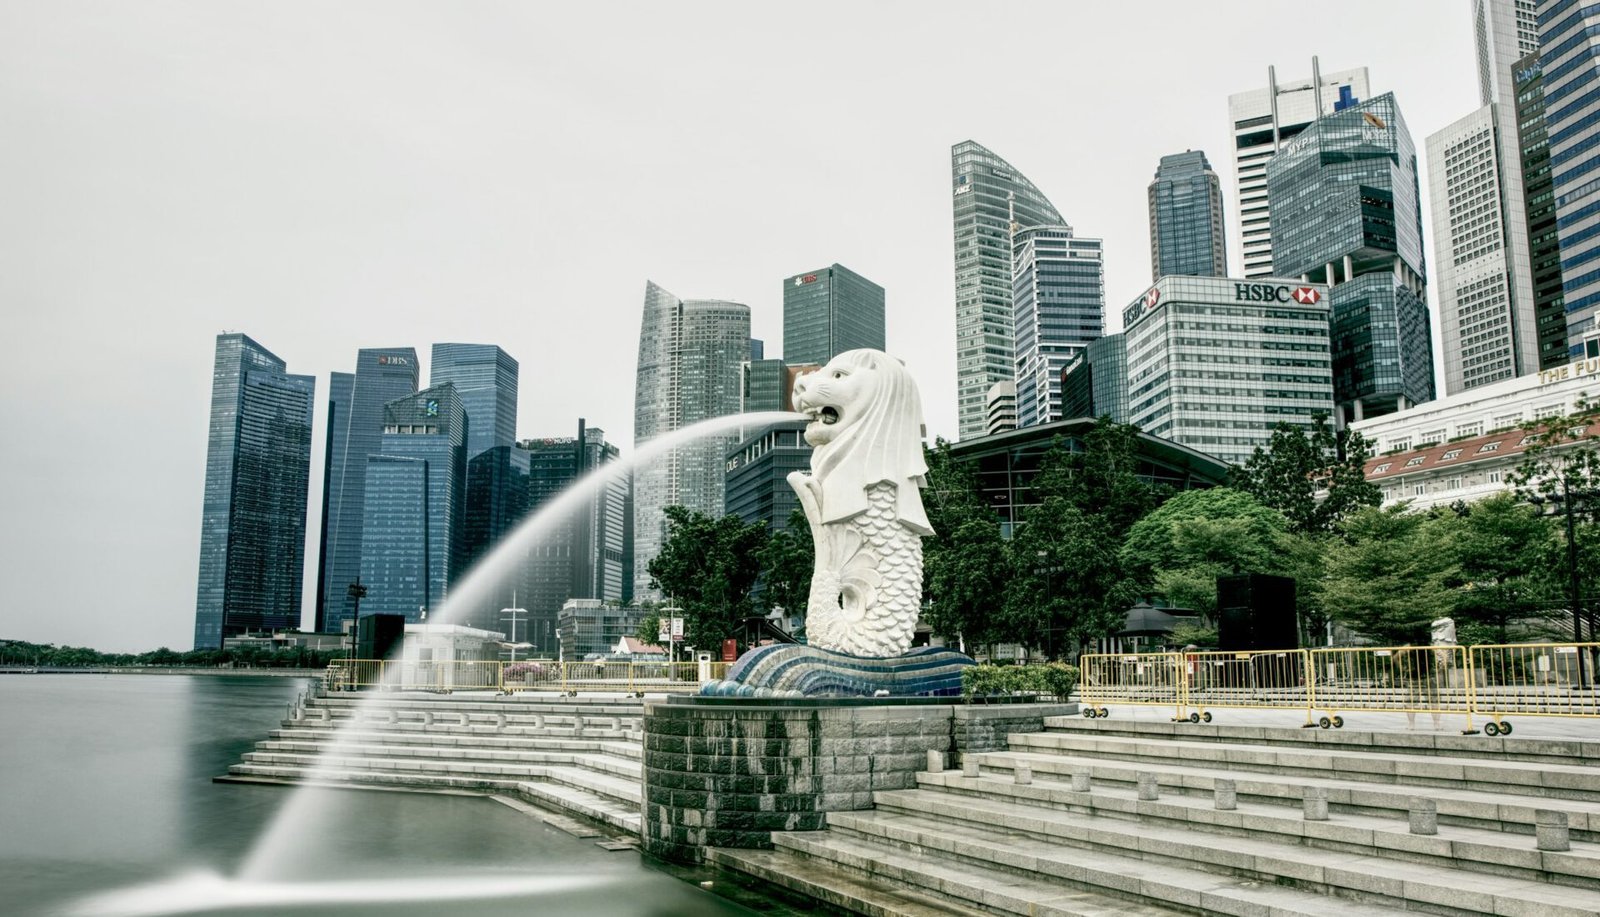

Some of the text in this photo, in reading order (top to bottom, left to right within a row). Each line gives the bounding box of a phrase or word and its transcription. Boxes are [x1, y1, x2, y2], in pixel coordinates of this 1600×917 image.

[1235, 283, 1290, 303] HSBC
[1123, 296, 1146, 328] HSBC
[388, 356, 408, 366] DBS
[1537, 358, 1600, 384] THE FU
[726, 457, 738, 473] OUE
